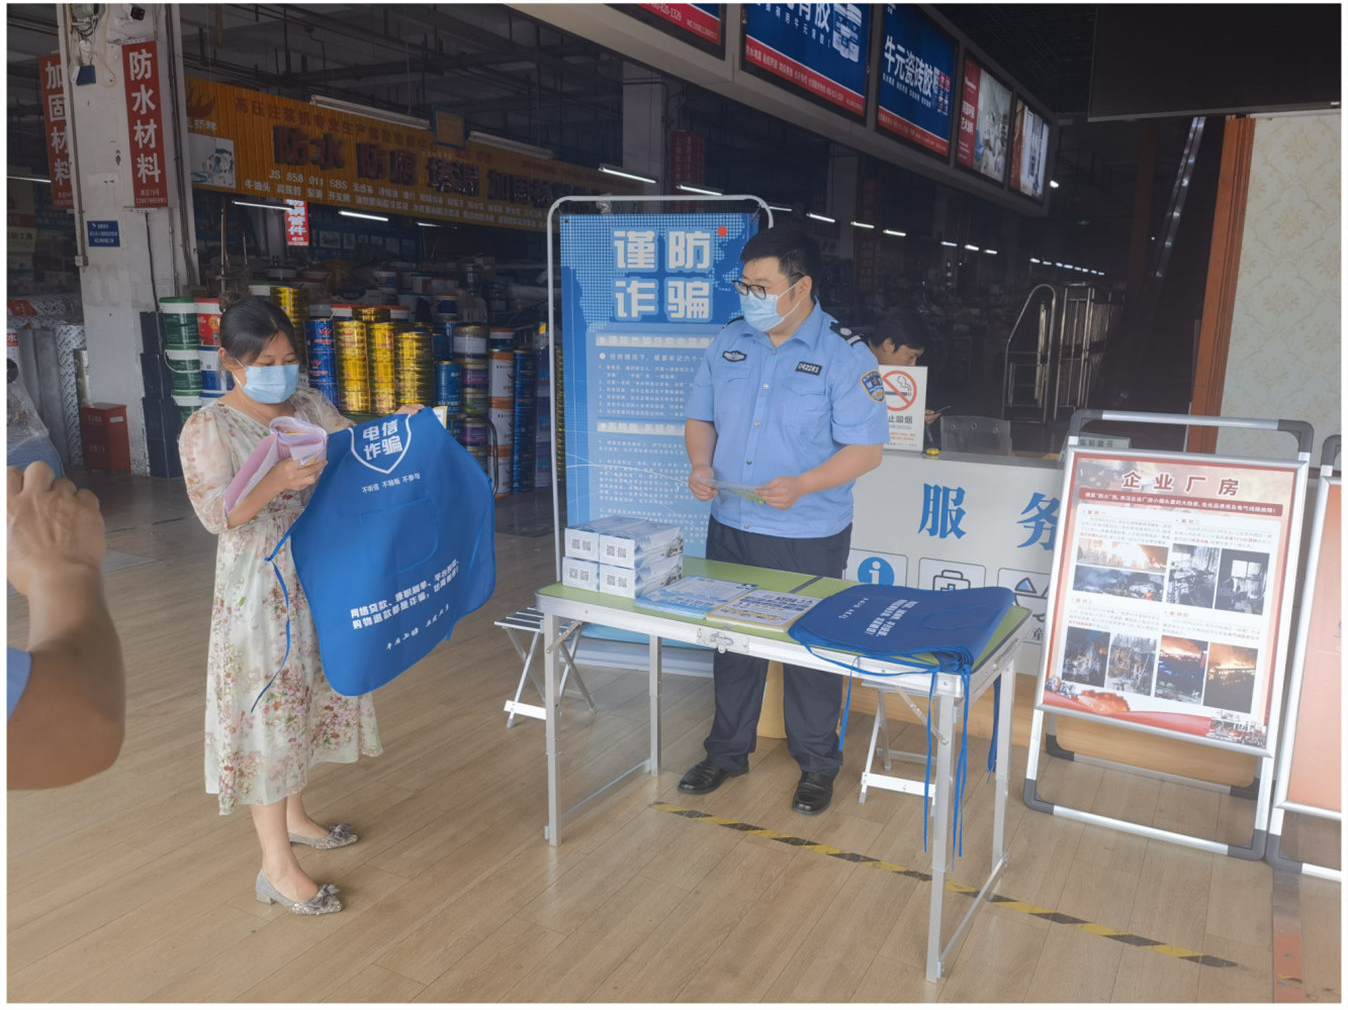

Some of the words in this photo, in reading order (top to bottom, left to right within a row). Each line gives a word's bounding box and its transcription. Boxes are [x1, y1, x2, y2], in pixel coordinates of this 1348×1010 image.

[128, 48, 161, 184] 防水材料
[273, 125, 346, 171] 防水
[614, 230, 712, 270] 谨防
[615, 279, 711, 319] 诈骗
[362, 419, 399, 442] 电信
[363, 435, 403, 461] 诈骗
[1121, 471, 1241, 497] 企业厂房
[918, 482, 1058, 552] 服务
